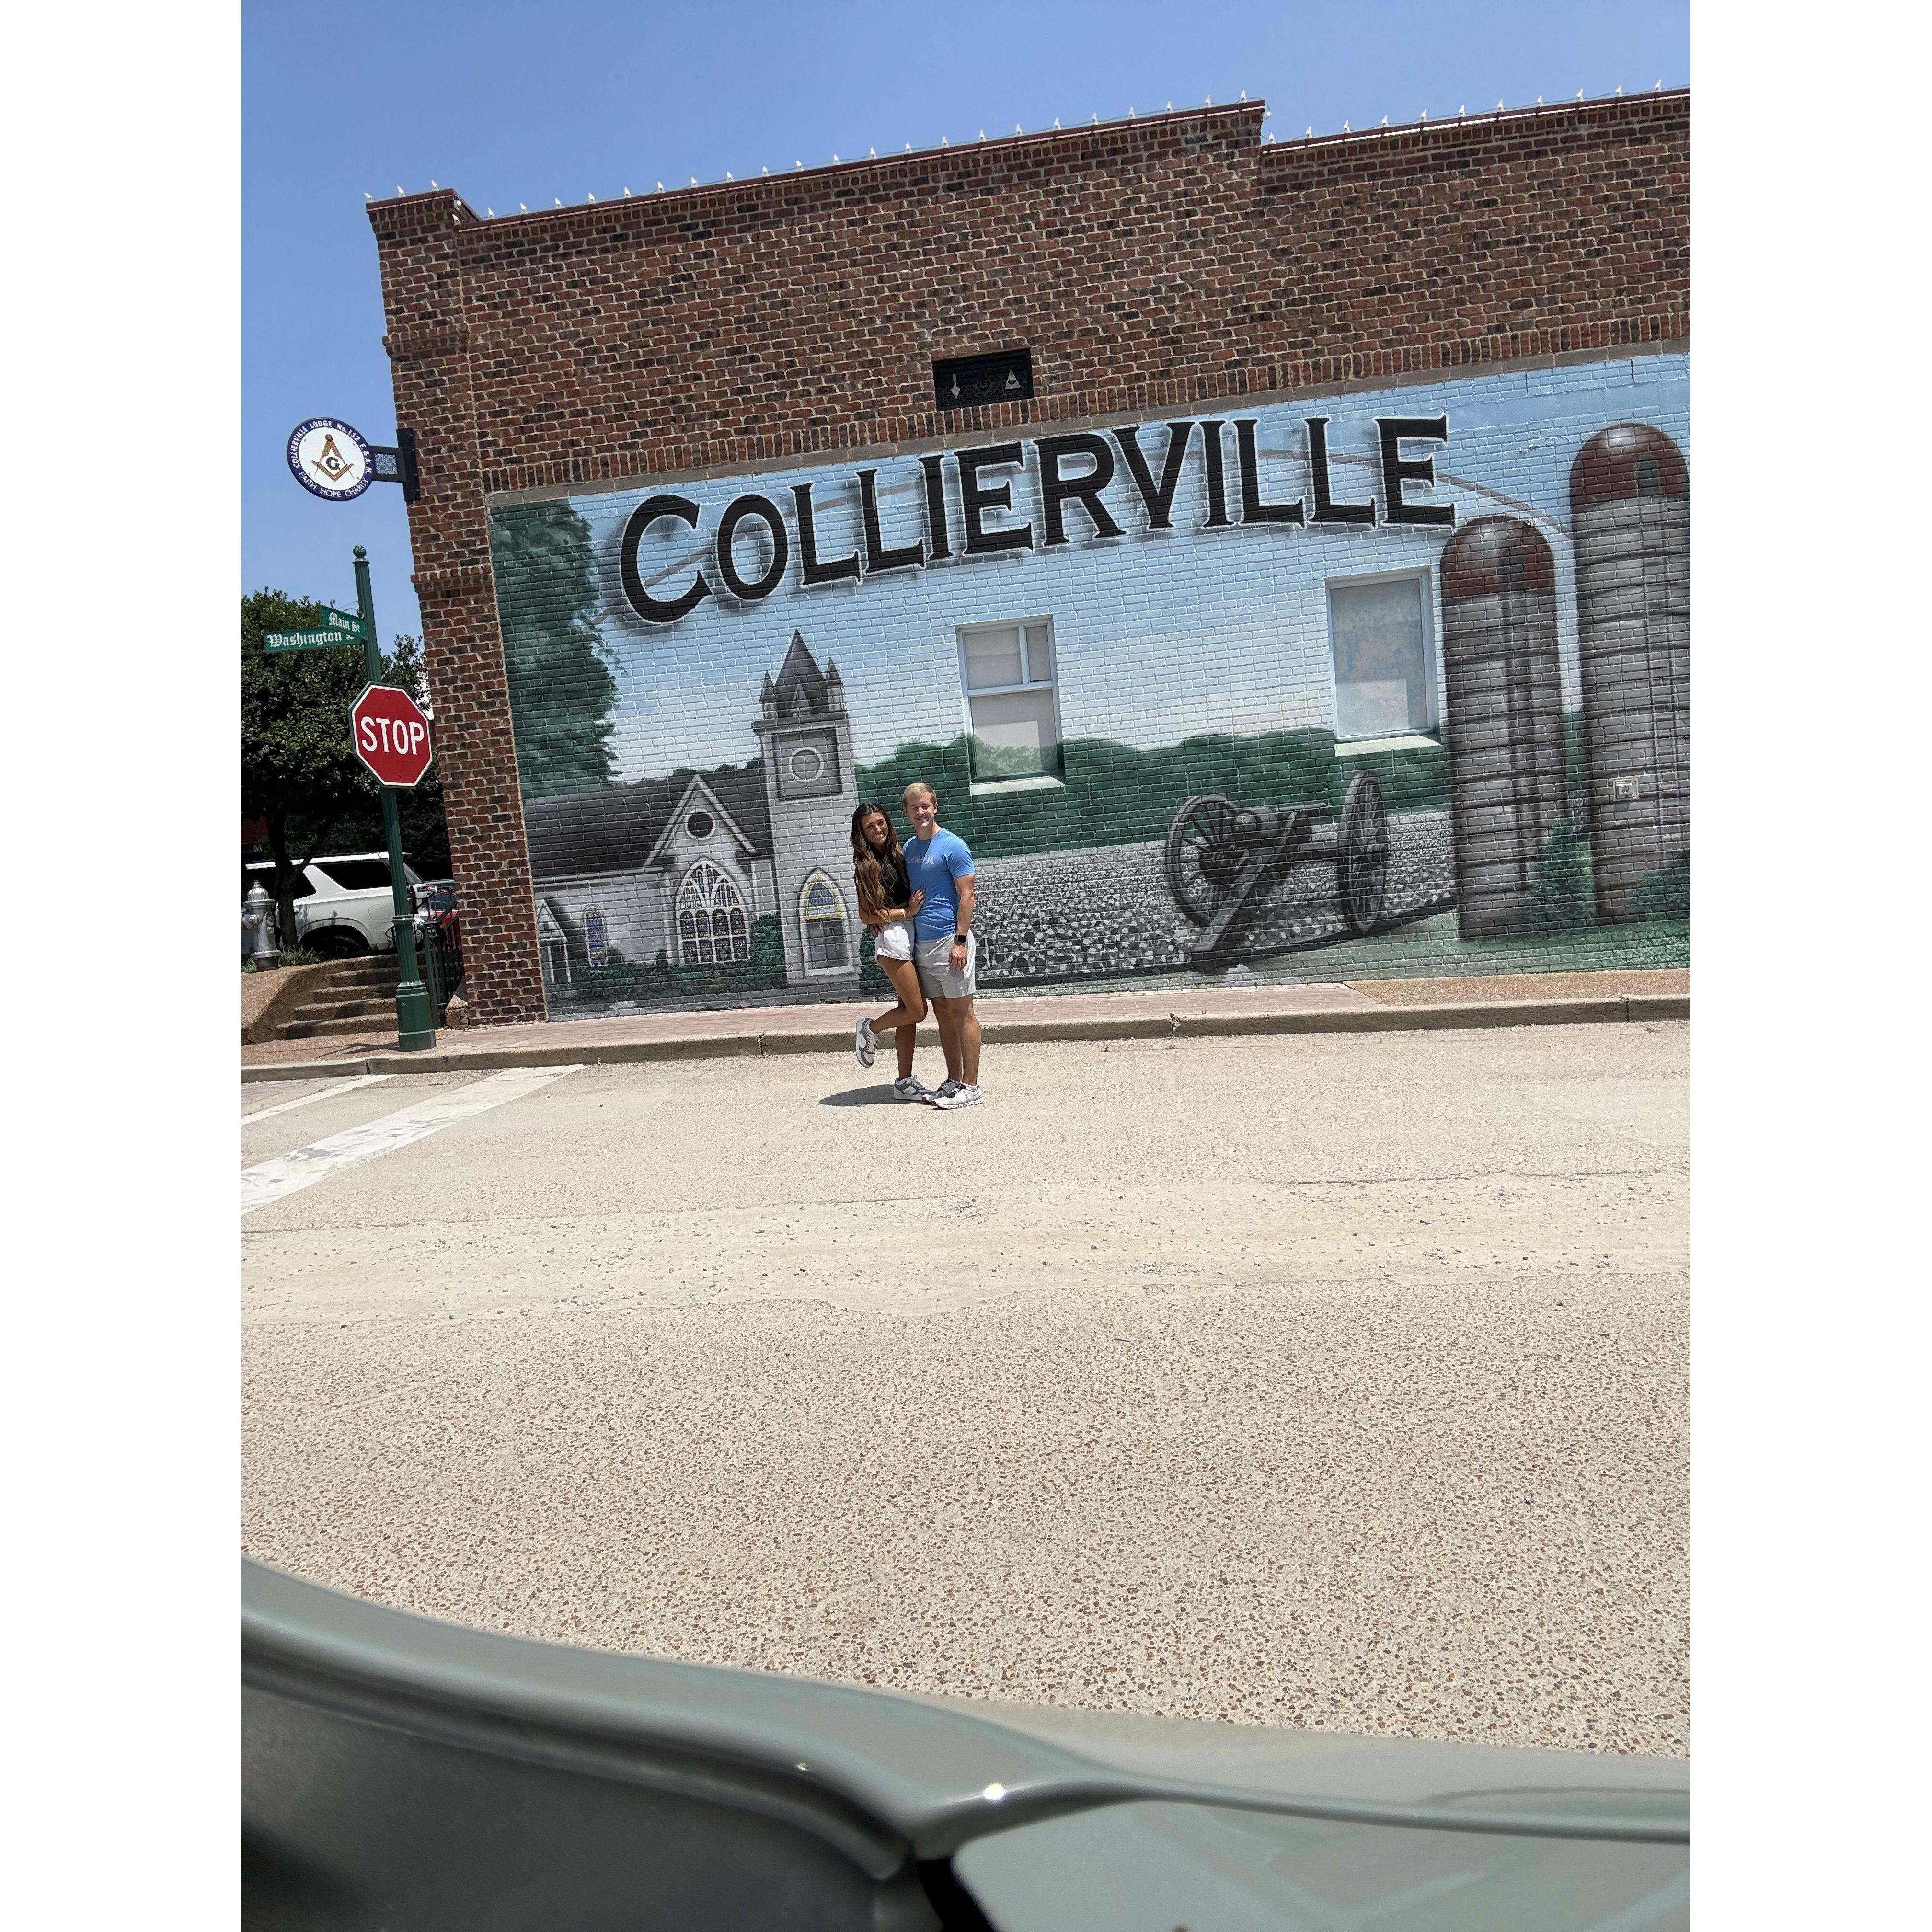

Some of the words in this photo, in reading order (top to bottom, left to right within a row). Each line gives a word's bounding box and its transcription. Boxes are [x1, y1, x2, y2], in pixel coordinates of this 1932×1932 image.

[290, 426, 308, 468] COLLIERVILLE
[309, 420, 333, 429] LODGE
[326, 457, 340, 471] G
[298, 472, 317, 490] FAITH
[320, 488, 342, 498] HOPE
[345, 477, 368, 496] CHARITY
[621, 414, 1456, 624] COLLIERVILLE
[329, 612, 349, 631] Main
[351, 621, 360, 633] St
[267, 631, 342, 647] Washington
[361, 716, 424, 755] STOP
